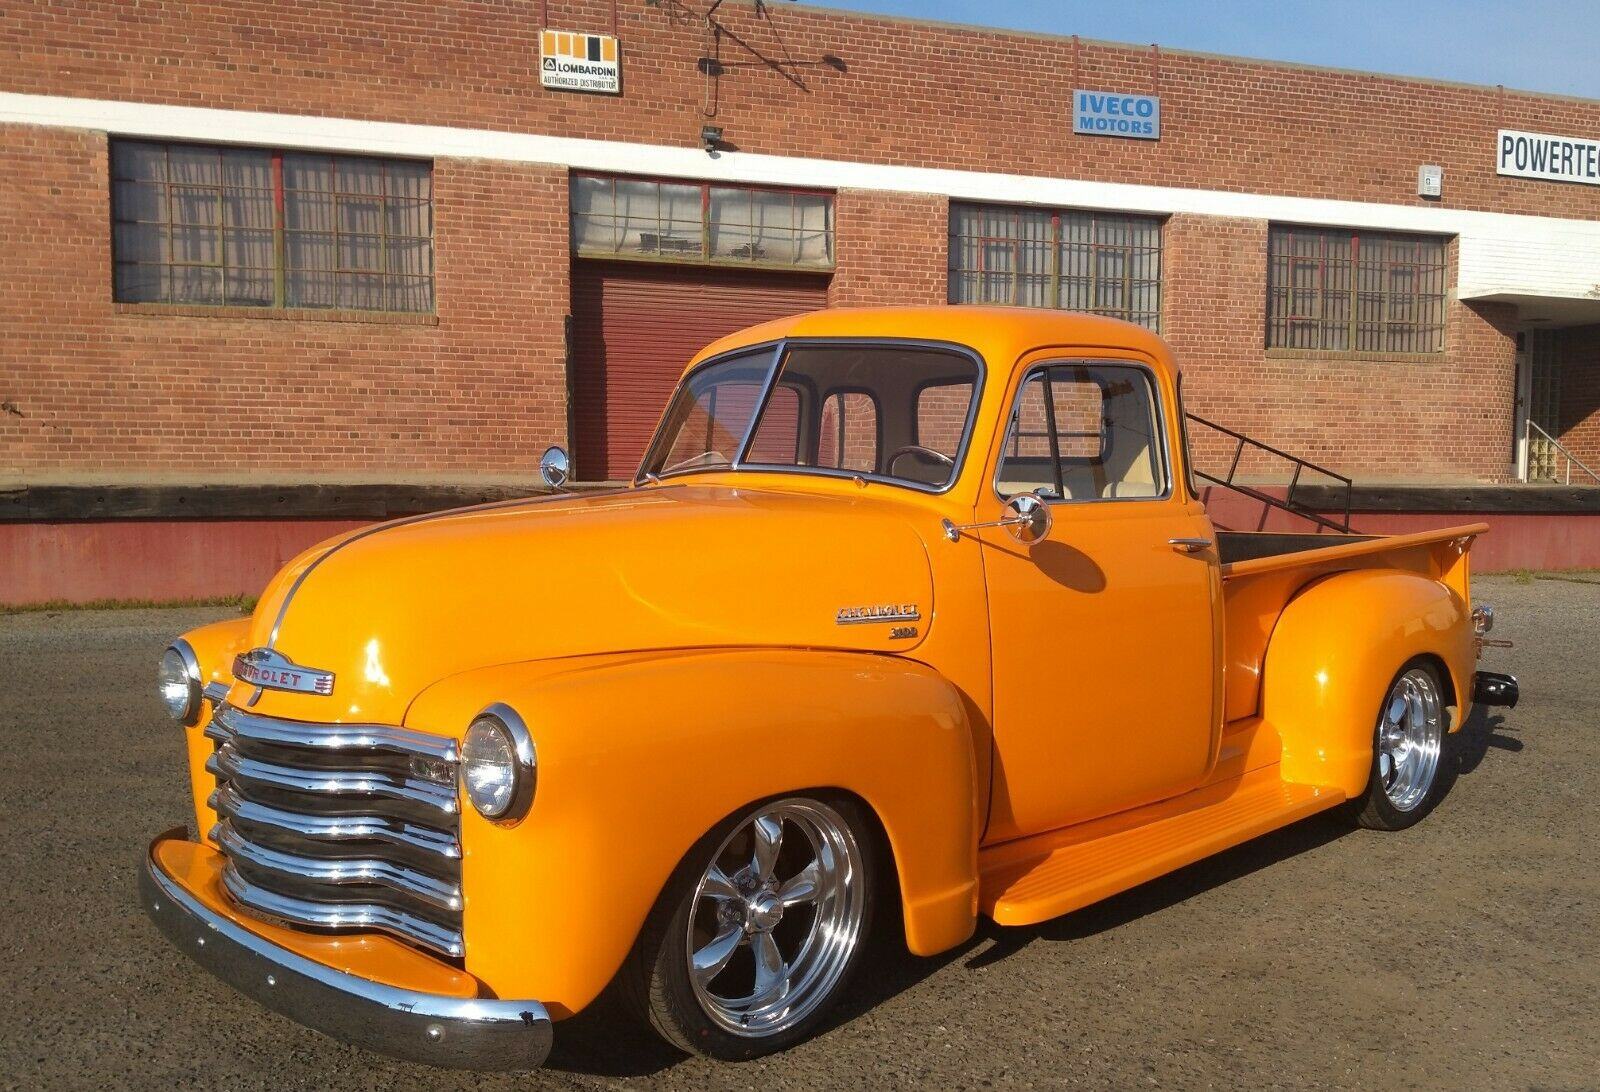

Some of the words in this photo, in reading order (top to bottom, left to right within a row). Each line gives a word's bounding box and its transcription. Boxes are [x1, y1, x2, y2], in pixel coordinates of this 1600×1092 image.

[558, 63, 616, 76] LOMBARDINI
[543, 75, 578, 88] AUTHORIZED
[580, 79, 617, 89] DISTRIBUTOR
[1080, 93, 1153, 117] IVECO
[1079, 116, 1153, 134] MOTORS
[1501, 135, 1600, 178] POWERTE
[837, 604, 918, 618] CHEVROLET
